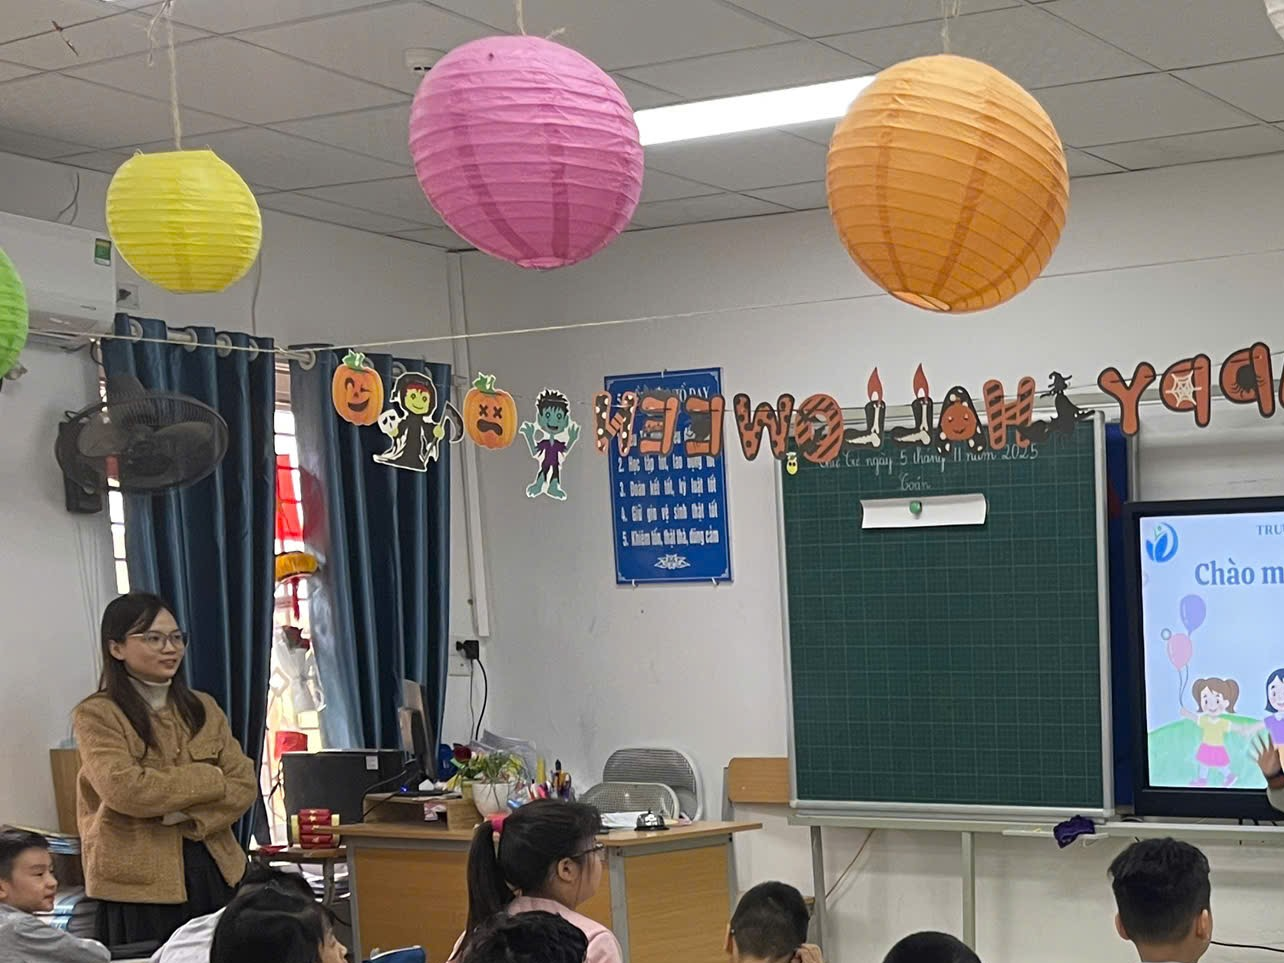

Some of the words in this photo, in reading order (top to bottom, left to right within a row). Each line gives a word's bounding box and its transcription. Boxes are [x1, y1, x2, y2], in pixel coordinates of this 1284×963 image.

[866, 452, 893, 476] ngày
[900, 449, 908, 466] 5
[953, 446, 962, 463] 11
[1001, 443, 1039, 461] 2025
[900, 473, 931, 492] Toán
[1194, 557, 1256, 587] Chào
